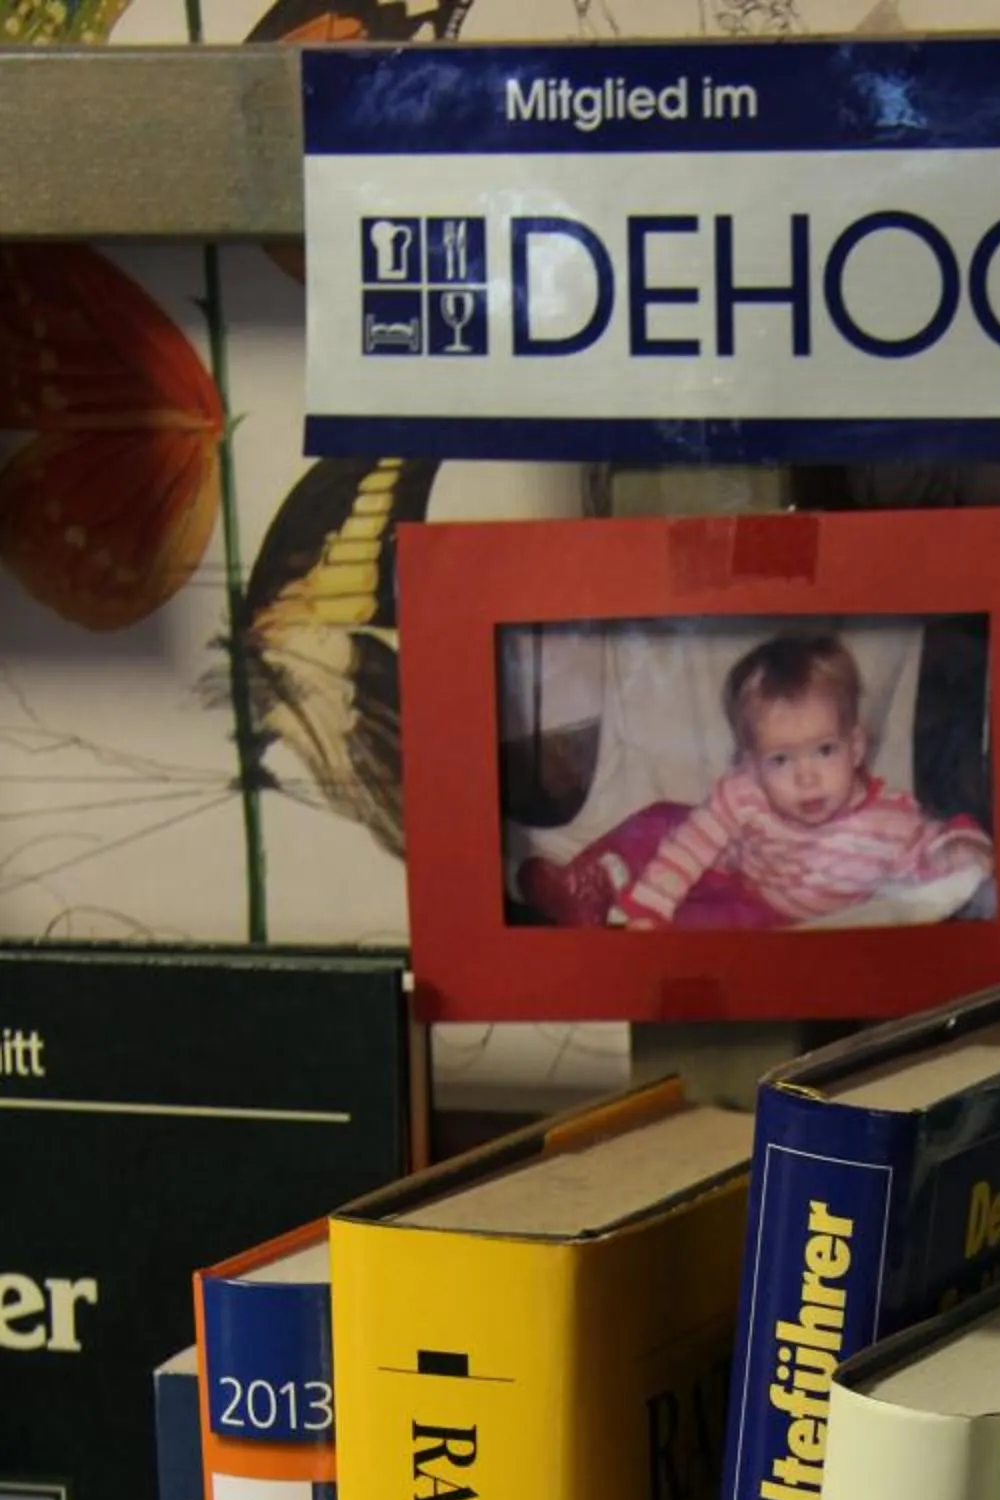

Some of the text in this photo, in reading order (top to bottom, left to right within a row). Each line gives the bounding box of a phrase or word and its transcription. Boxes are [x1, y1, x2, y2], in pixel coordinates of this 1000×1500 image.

[506, 79, 757, 131] Mitglied im
[0, 1028, 45, 1076] itt
[219, 1376, 333, 1430] 2013
